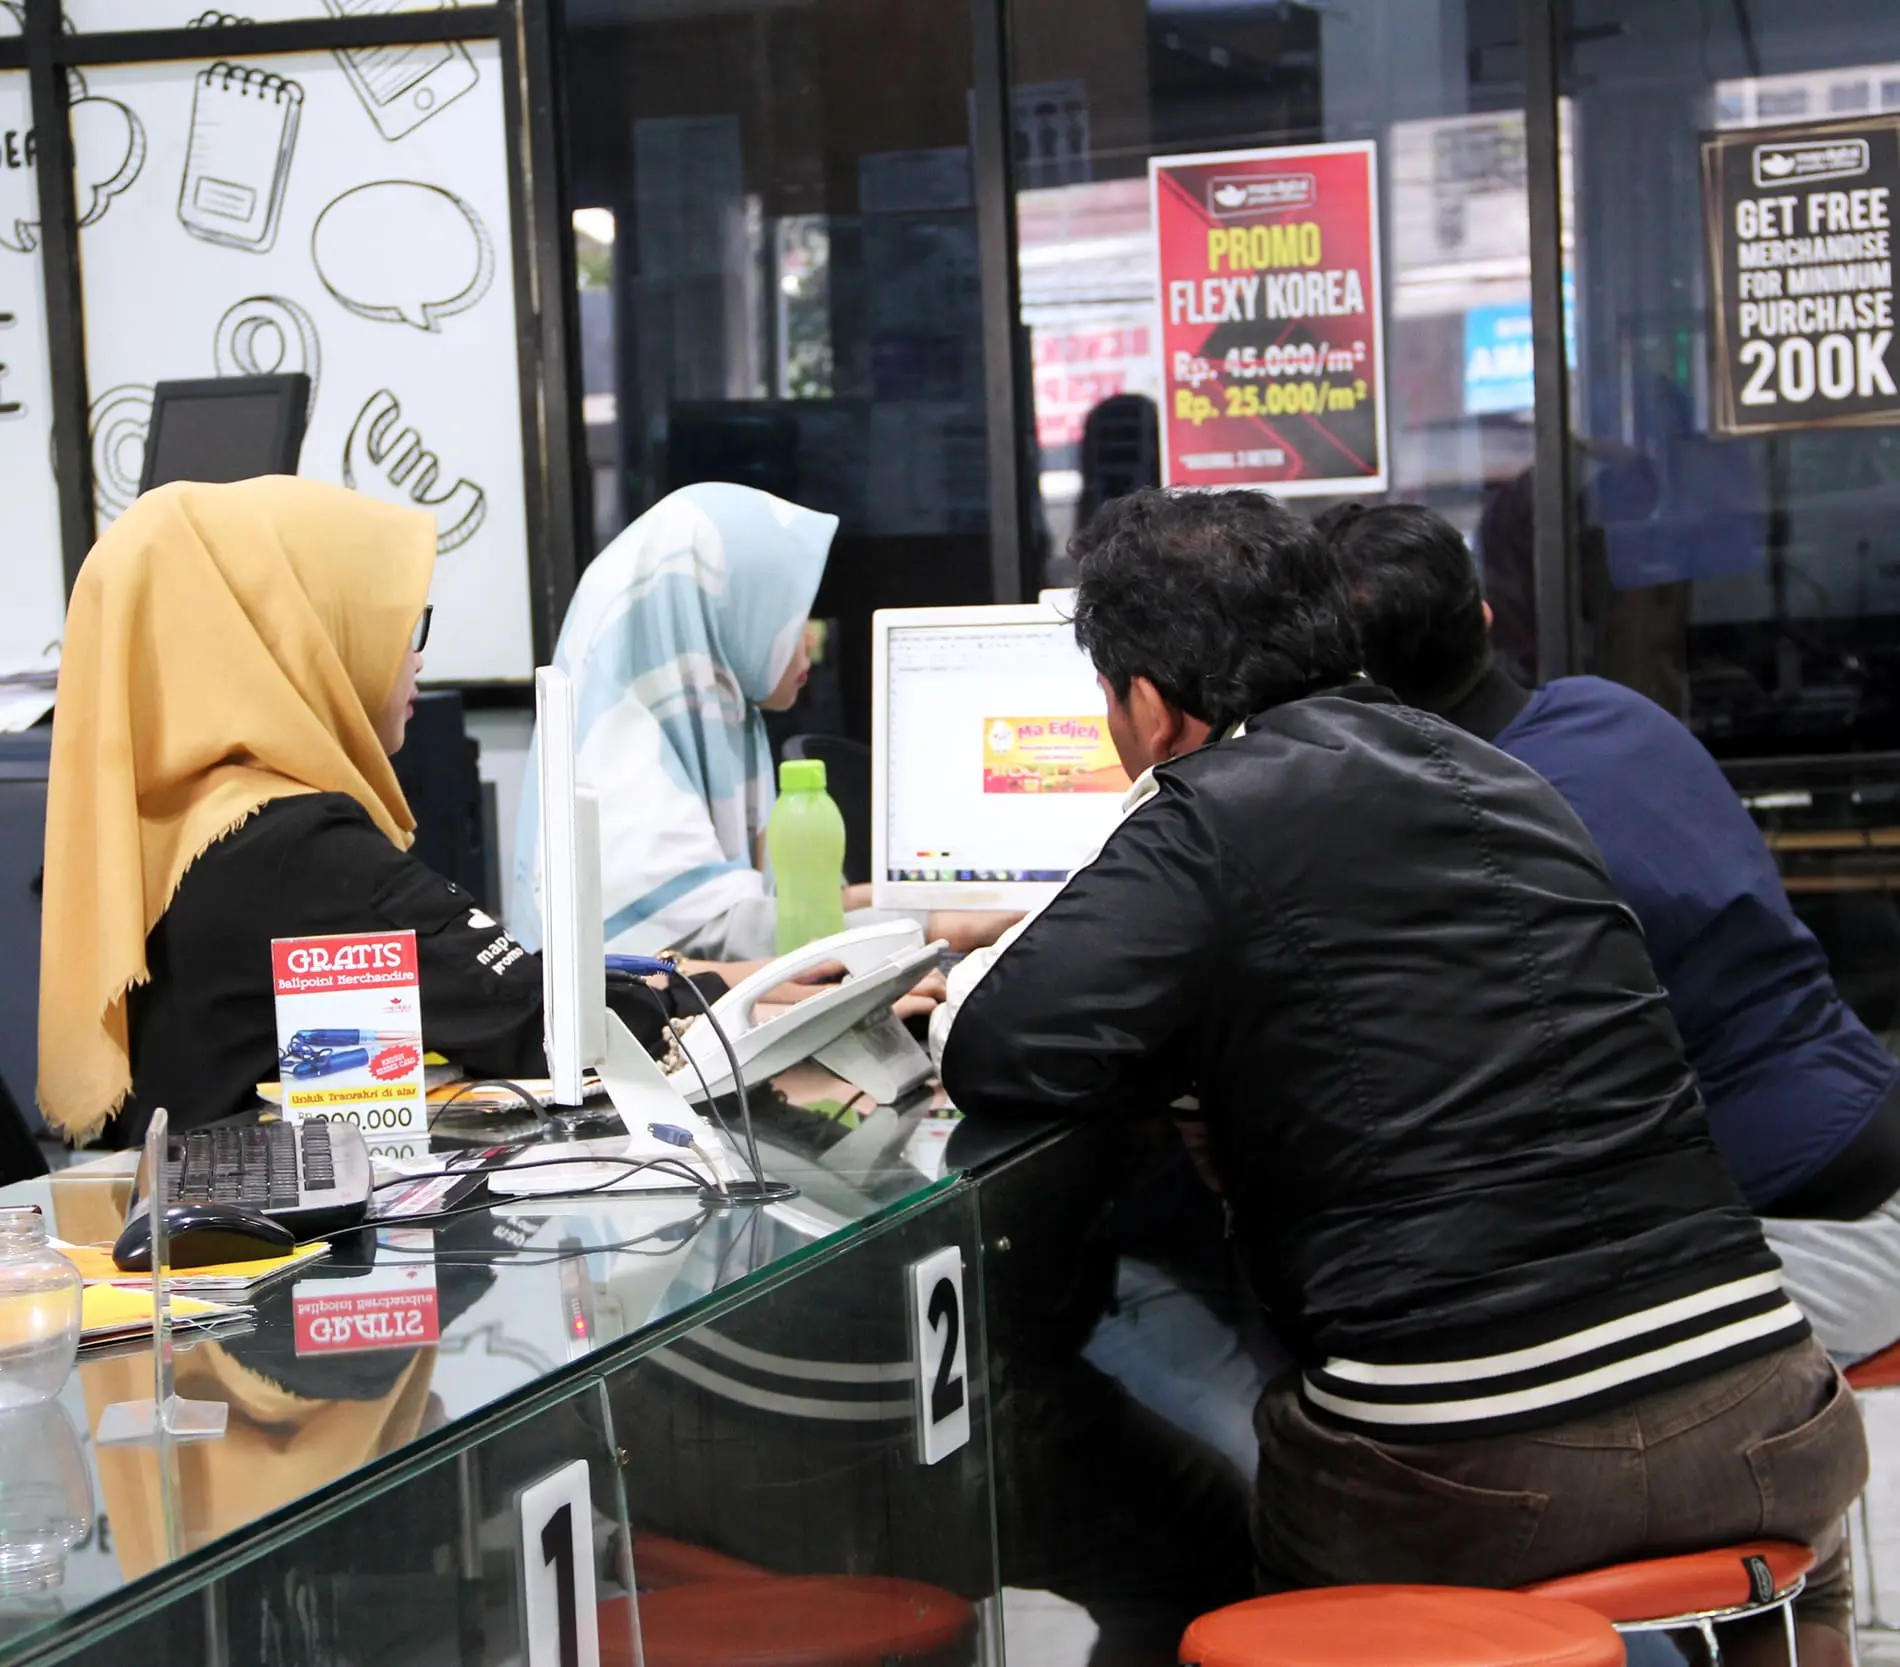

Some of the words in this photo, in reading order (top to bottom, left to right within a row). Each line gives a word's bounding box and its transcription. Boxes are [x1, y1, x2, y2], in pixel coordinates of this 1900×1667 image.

[1736, 195, 1798, 240] GET
[1807, 187, 1891, 233] FREE
[1208, 222, 1321, 272] PROMO
[1738, 230, 1891, 269] MERCHANDISE
[1170, 275, 1259, 325] FLEXY
[1266, 270, 1365, 320] KOREA
[1738, 270, 1783, 300] FOR
[1787, 261, 1892, 295] MINIMUM
[1739, 291, 1894, 338] PURCHASE
[1173, 351, 1218, 388] Rp.
[1740, 331, 1898, 405] 200K
[1175, 389, 1219, 425] Rp.
[287, 942, 402, 973] GRATIS
[279, 976, 333, 990] Ballpoint
[337, 971, 414, 985] Merchandise
[292, 1093, 324, 1104] Untuk
[381, 1088, 393, 1097] di
[927, 1277, 965, 1425] 2
[541, 1502, 580, 1667] 1
